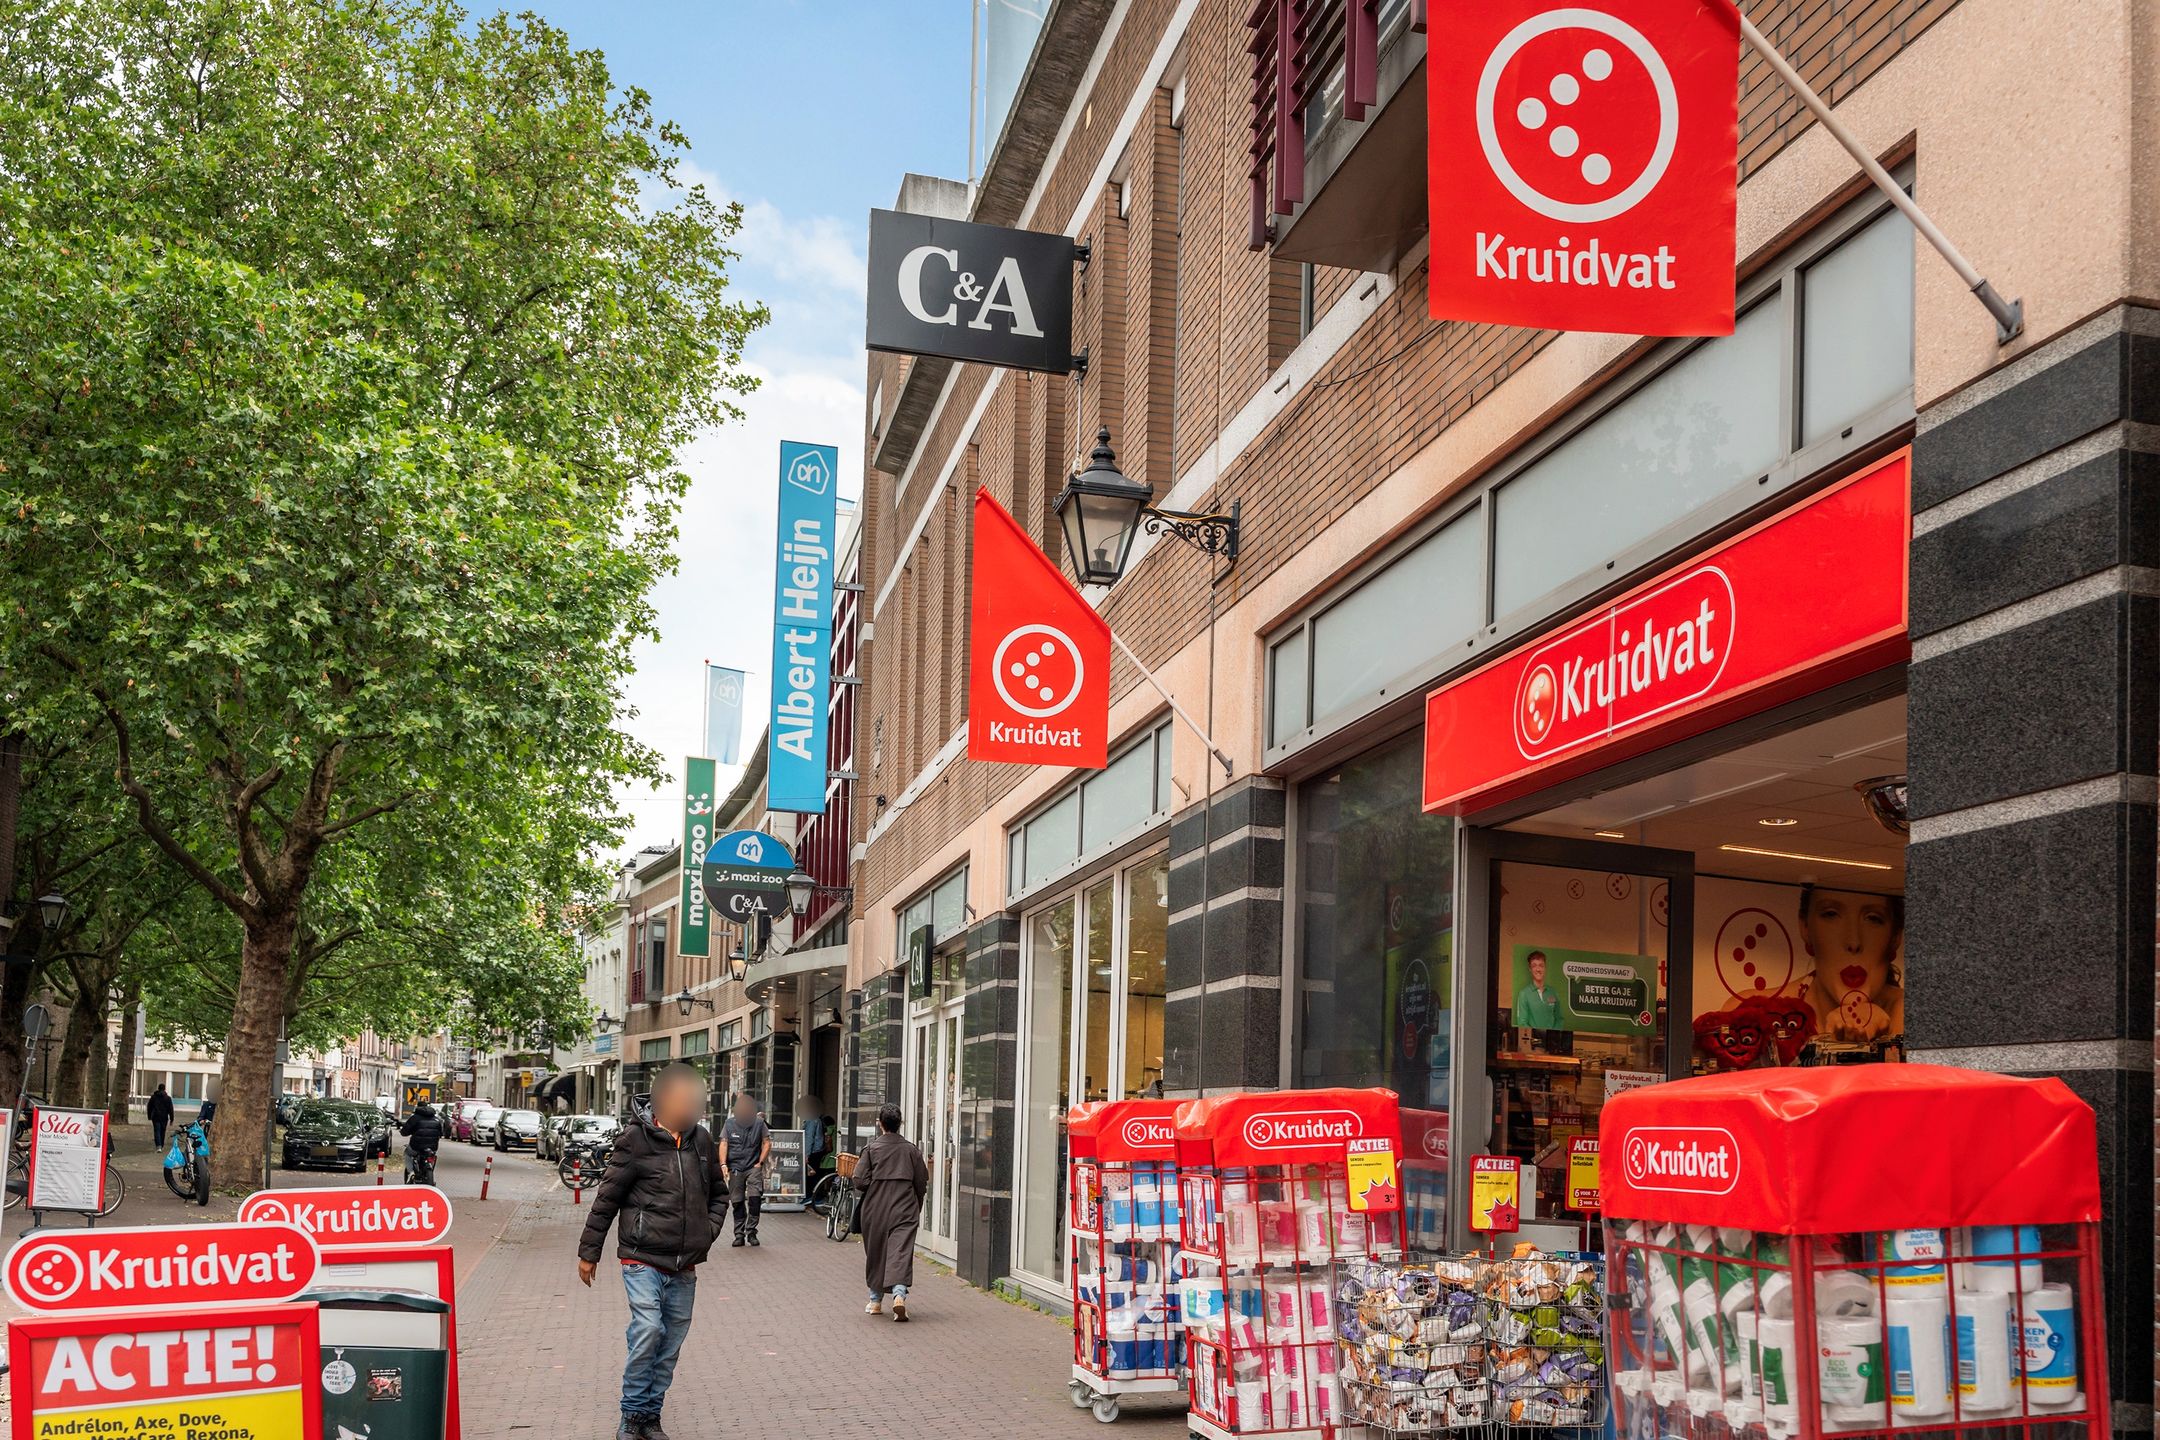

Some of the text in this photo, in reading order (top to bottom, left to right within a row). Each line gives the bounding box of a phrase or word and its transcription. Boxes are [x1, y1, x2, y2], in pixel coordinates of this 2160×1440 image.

[1475, 231, 1676, 290] Kruidvat
[897, 245, 1044, 338] C&A
[777, 517, 828, 761] Albert Heijn
[1561, 597, 1715, 723] Kruidvat
[989, 721, 1082, 747] Kruidvat
[685, 824, 706, 926] maxi zoo
[731, 872, 783, 884] maxi zoo
[730, 894, 768, 914] C&A
[1567, 965, 1630, 977] GEZONDHEIDSVRAAG?
[1585, 985, 1631, 996] BETER GA JE
[1579, 995, 1637, 1007] NAAR KRUIDVAT
[1619, 1074, 1652, 1082] kruidvat.nl
[1275, 1119, 1353, 1139] Kruidvat
[1349, 1138, 1389, 1152] ACTIE!
[1574, 1139, 1600, 1151] ACTI
[1477, 1158, 1515, 1171] ACTIE!
[1647, 1140, 1729, 1179] Kruidvat
[1574, 1189, 1580, 1197] 6
[294, 1200, 435, 1233] Kruidvat
[1914, 1246, 1933, 1256] XXL
[89, 1243, 296, 1291] Kruidvat
[2012, 1327, 2045, 1336] EKEN
[41, 1325, 277, 1394] ACTIE!
[41, 1413, 227, 1435] Andrélon, Axe, Dove,
[187, 1429, 255, 1440] Rexona,
